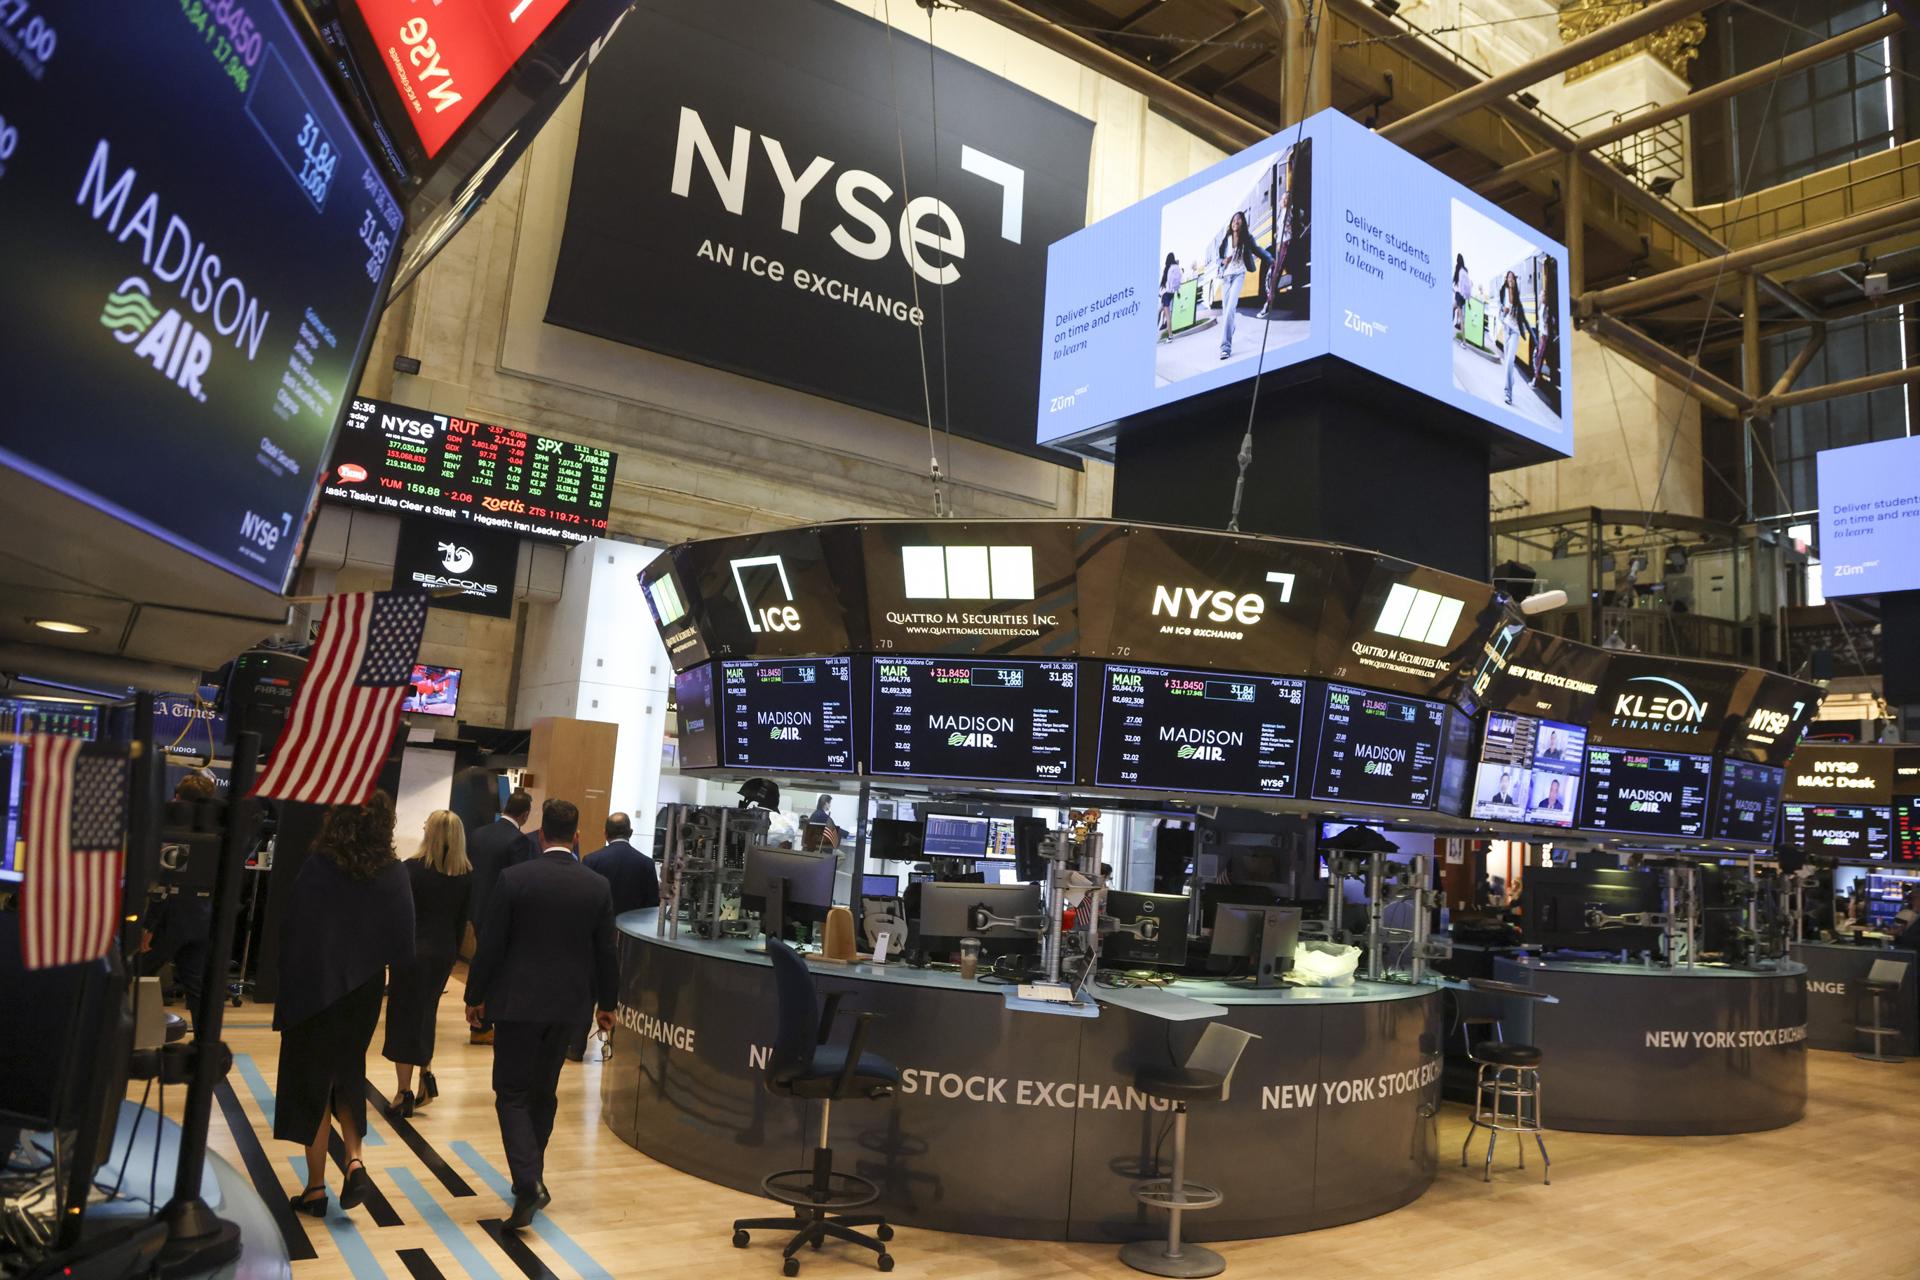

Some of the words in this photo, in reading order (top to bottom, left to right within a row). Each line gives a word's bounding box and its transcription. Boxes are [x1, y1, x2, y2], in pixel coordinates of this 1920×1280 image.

[1346, 209, 1382, 239] Deliver
[1385, 233, 1430, 264] students
[76, 138, 270, 361] MADISON
[697, 239, 733, 268] AN
[1345, 252, 1355, 265] to
[1357, 255, 1384, 280] learn
[1346, 232, 1359, 247] on
[1361, 239, 1385, 260] time
[1388, 254, 1406, 271] and
[1410, 266, 1436, 289] ready
[1056, 306, 1088, 326] Deliver
[1090, 286, 1134, 312] students
[1055, 331, 1066, 343] on
[1068, 322, 1089, 338] time
[1092, 312, 1110, 329] and
[1112, 300, 1141, 320] ready
[1054, 350, 1061, 360] to
[1063, 340, 1088, 357] learn
[352, 400, 376, 413] 5:36
[449, 418, 479, 435] RUT
[536, 438, 563, 455] SPX
[380, 477, 402, 489] YUM
[407, 483, 440, 497] 159.88
[379, 496, 398, 507] Like
[400, 500, 424, 511] Clear
[482, 497, 525, 514] zoetis
[529, 506, 546, 517] ZTS
[549, 511, 580, 524] 119.72
[1833, 503, 1871, 514] Deliver
[1833, 518, 1847, 526] on
[1850, 515, 1874, 524] time
[1877, 511, 1898, 520] and
[514, 521, 530, 532] Iran
[531, 524, 561, 536] Leader
[561, 530, 587, 542] Status
[1834, 530, 1843, 538] to
[1846, 528, 1874, 537] learn
[412, 572, 497, 593] BEACONS
[886, 611, 943, 624] QUATTRO
[946, 613, 959, 624] M
[962, 613, 1029, 625] SECURITIES
[1160, 626, 1173, 634] AN
[1352, 642, 1388, 658] QUATTRO
[1388, 651, 1397, 660] M
[1396, 651, 1436, 668] SECURITIES
[727, 669, 743, 678] MAIR
[880, 665, 907, 676] MAIR
[936, 669, 970, 678] 31.8450
[998, 670, 1021, 680] 31.84
[1049, 672, 1073, 681] 31.85
[1508, 664, 1527, 678] NEW
[1525, 669, 1543, 682] YORK
[1543, 673, 1565, 688] STOCK
[1565, 677, 1598, 695] EXCHANGE
[1112, 685, 1144, 693] 20,844,776
[1113, 673, 1142, 686] MAIR
[1170, 680, 1204, 690] 31.8450
[1230, 684, 1253, 694] 31.84
[1279, 689, 1301, 698] 31.85
[1112, 696, 1144, 705] 82,692,308
[1331, 693, 1350, 705] MAIR
[1615, 694, 1708, 722] KLEON
[172, 703, 216, 720] Times
[757, 712, 811, 725] MADISON
[929, 714, 1014, 732] MADISON
[1611, 719, 1699, 735] FINANCIAL
[1159, 726, 1243, 746] MADISON
[164, 745, 197, 754] STUDIOS
[1355, 743, 1406, 762] MADISON
[1797, 775, 1834, 787] MAC
[1836, 776, 1876, 789] Desk
[1619, 788, 1673, 802] MADISON
[1812, 829, 1860, 839] MADISON
[625, 1007, 695, 1053] EXCHANGE
[1646, 1030, 1688, 1048] NEW
[1692, 1031, 1736, 1048] YORK
[1739, 1029, 1776, 1047] STOCK
[901, 1068, 1008, 1104] STOCK
[1262, 1083, 1317, 1110] NEW
[1323, 1077, 1375, 1105] YORK
[1378, 1067, 1420, 1098] STOCK
